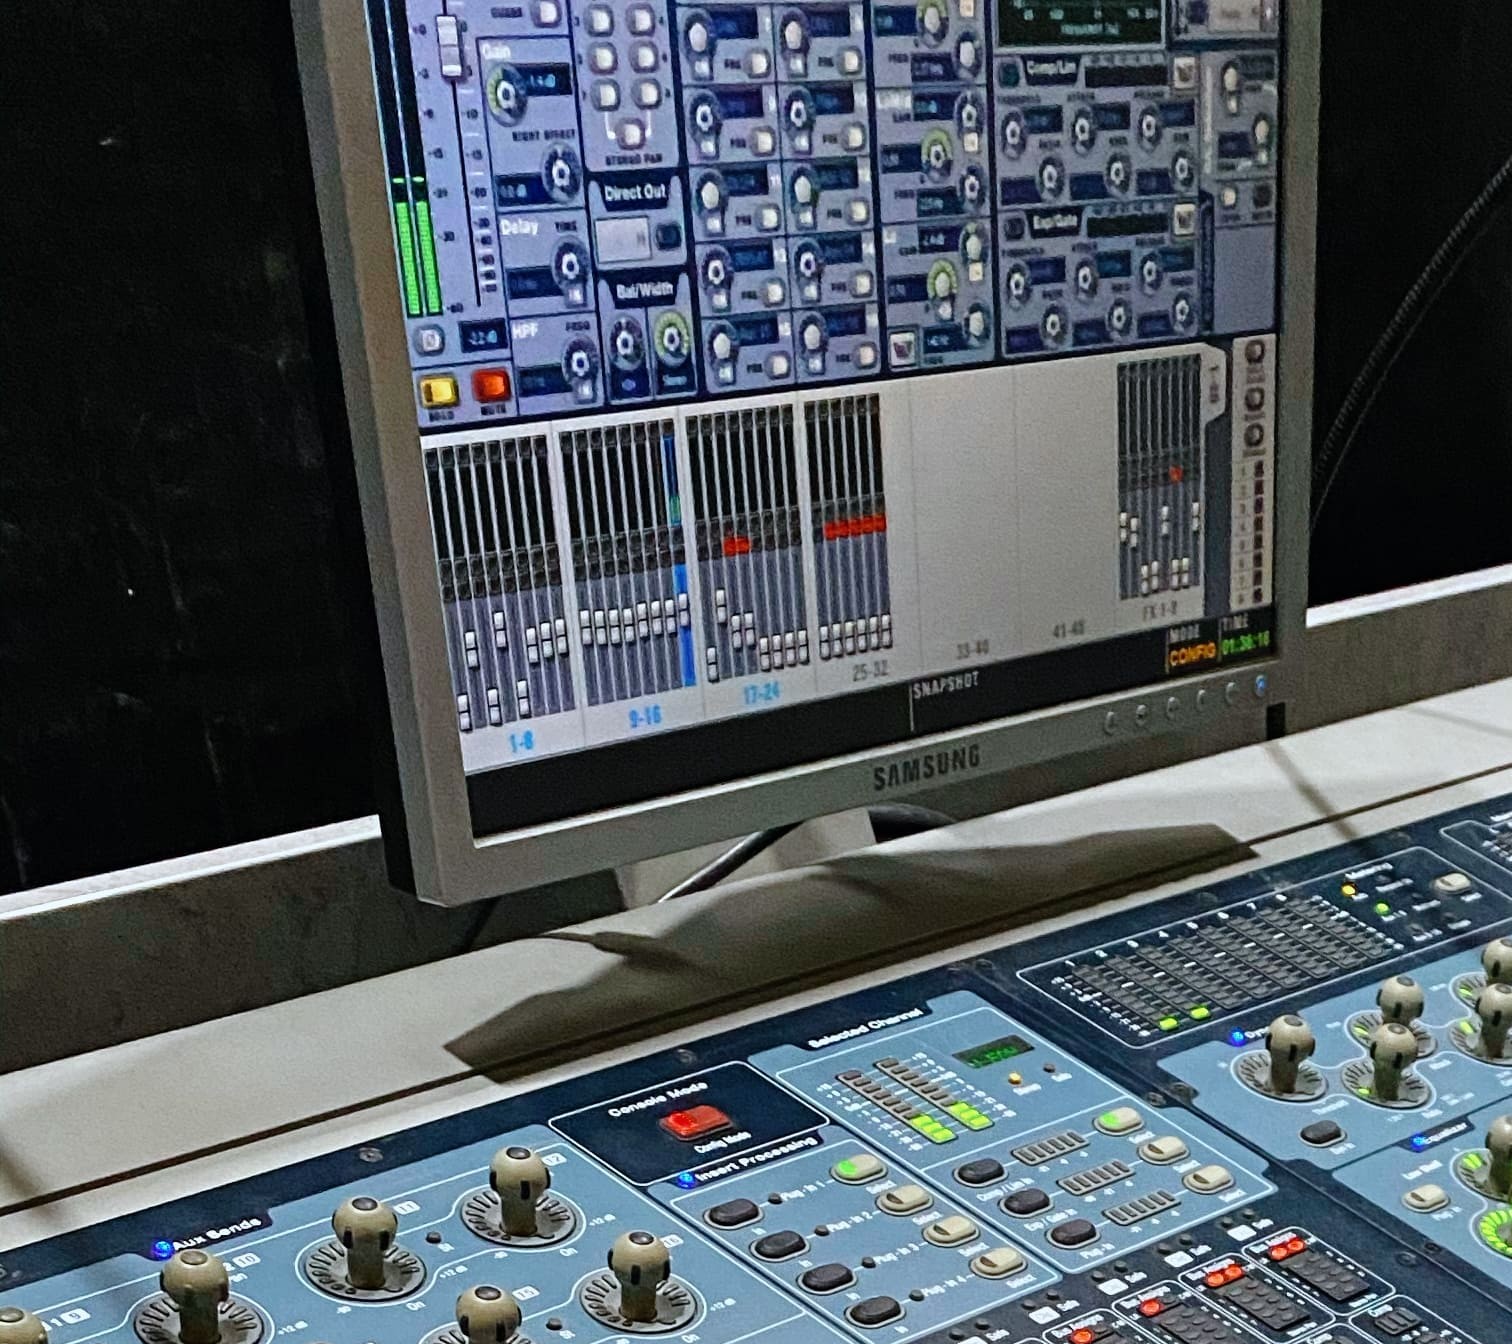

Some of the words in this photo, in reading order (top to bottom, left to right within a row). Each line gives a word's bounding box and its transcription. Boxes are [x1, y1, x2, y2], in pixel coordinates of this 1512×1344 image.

[604, 185, 639, 202] Direct
[643, 184, 668, 200] Out
[501, 218, 539, 236] Delay
[744, 681, 780, 706] 17-24
[912, 670, 981, 700] SNAPSHOT
[628, 704, 662, 728] 9-16
[509, 730, 535, 752] 1-8
[873, 744, 981, 792] SAMSUNG
[695, 1161, 739, 1183] Insert
[742, 1135, 819, 1170] Processing
